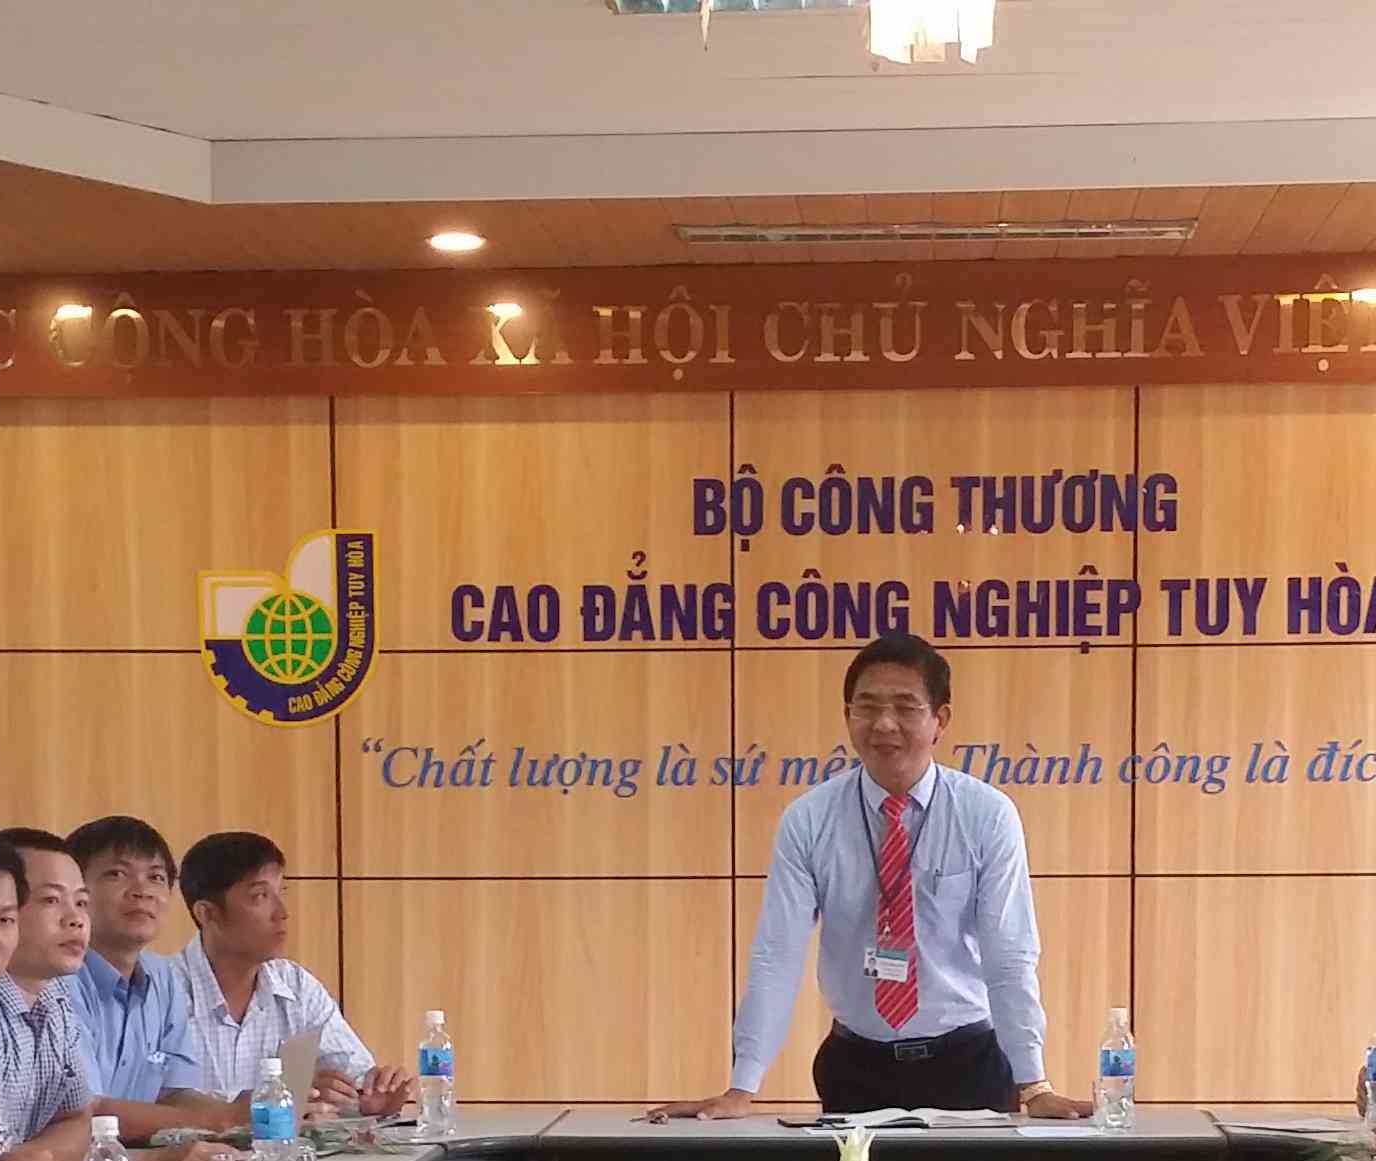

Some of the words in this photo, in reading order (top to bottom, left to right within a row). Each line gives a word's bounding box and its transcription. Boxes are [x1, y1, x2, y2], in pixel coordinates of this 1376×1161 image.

[49, 291, 257, 382] CỘNG
[288, 288, 444, 368] HÒA
[593, 286, 735, 380] HỘI
[765, 273, 927, 363] CHỦ
[955, 279, 1205, 361] NGHĨA
[693, 463, 764, 552] BỘ
[781, 463, 934, 537] CÔNG
[949, 468, 1178, 534] THƯƠNG
[288, 694, 314, 714] CAO
[347, 572, 366, 598] TUY
[451, 583, 561, 643] CAO
[580, 550, 736, 642] ĐẲNG
[756, 568, 911, 640] CÔNG
[932, 564, 1142, 654] NGHIỆP
[1161, 577, 1267, 637] TUY
[509, 746, 643, 799] lượng
[656, 742, 697, 786] là
[708, 743, 766, 786] sứ
[952, 742, 1103, 786] Thành
[1118, 738, 1231, 796] công
[1245, 739, 1289, 785] là
